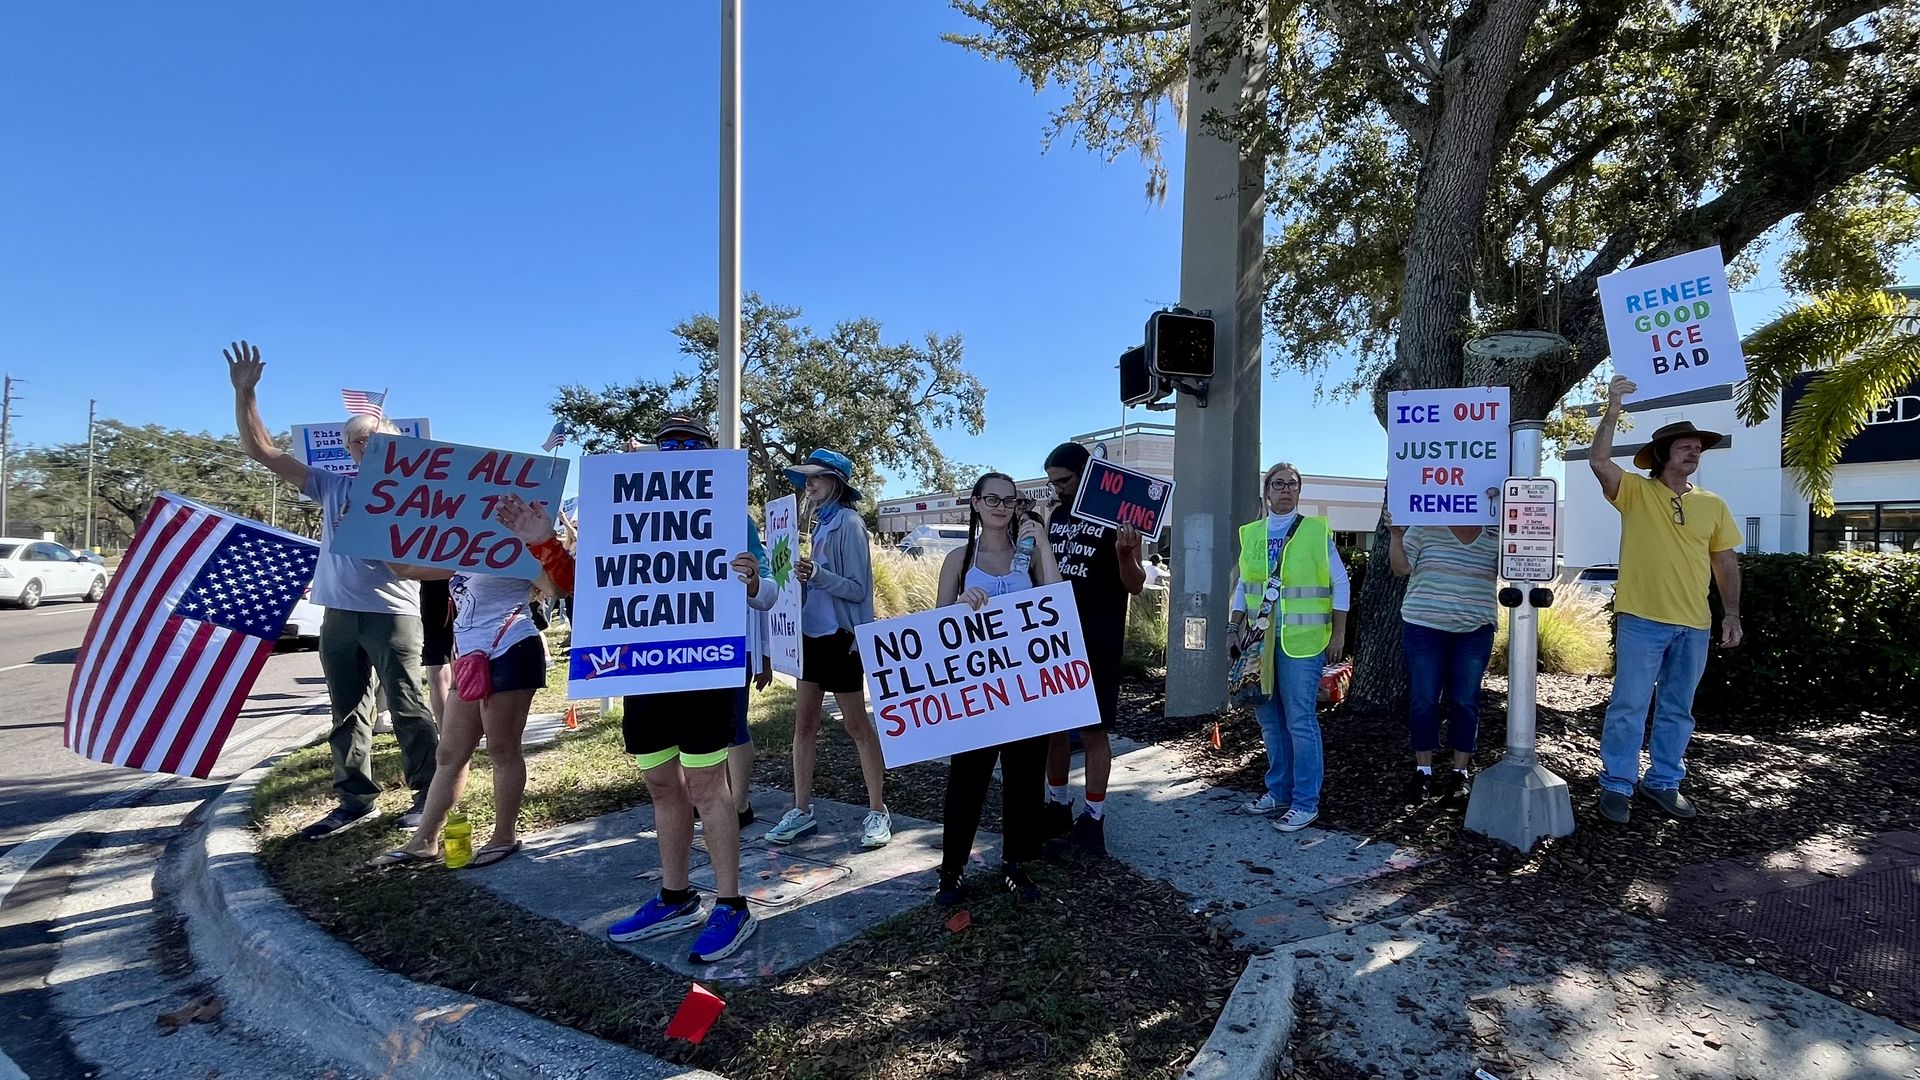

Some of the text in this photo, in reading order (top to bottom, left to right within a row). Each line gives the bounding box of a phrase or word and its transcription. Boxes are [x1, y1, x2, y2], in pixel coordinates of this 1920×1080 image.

[1625, 276, 1712, 313] RENEE
[1634, 300, 1710, 333] GOOD
[1651, 324, 1703, 352] ICE
[1652, 347, 1709, 375] BAD
[1397, 402, 1500, 423] ICE OUT
[313, 430, 341, 438] This
[1395, 441, 1497, 460] JUSTICE
[384, 441, 541, 488] WE ALL
[1421, 467, 1465, 486] FOR
[613, 469, 713, 503] MAKE
[1099, 469, 1124, 494] NO
[365, 480, 466, 519] SAW
[1116, 500, 1156, 530] KING
[1409, 494, 1478, 513] RENEE
[611, 509, 712, 545] LYING
[389, 524, 523, 568] VIDEO
[1051, 540, 1066, 554] nd
[595, 549, 728, 587] WRONG
[602, 591, 715, 630] AGAIN
[874, 597, 1060, 667] NO ONE IS
[631, 644, 735, 667] NO KINGS
[872, 631, 1071, 700] ILLEGAL ON
[880, 659, 1091, 737] STOLEN LAND
